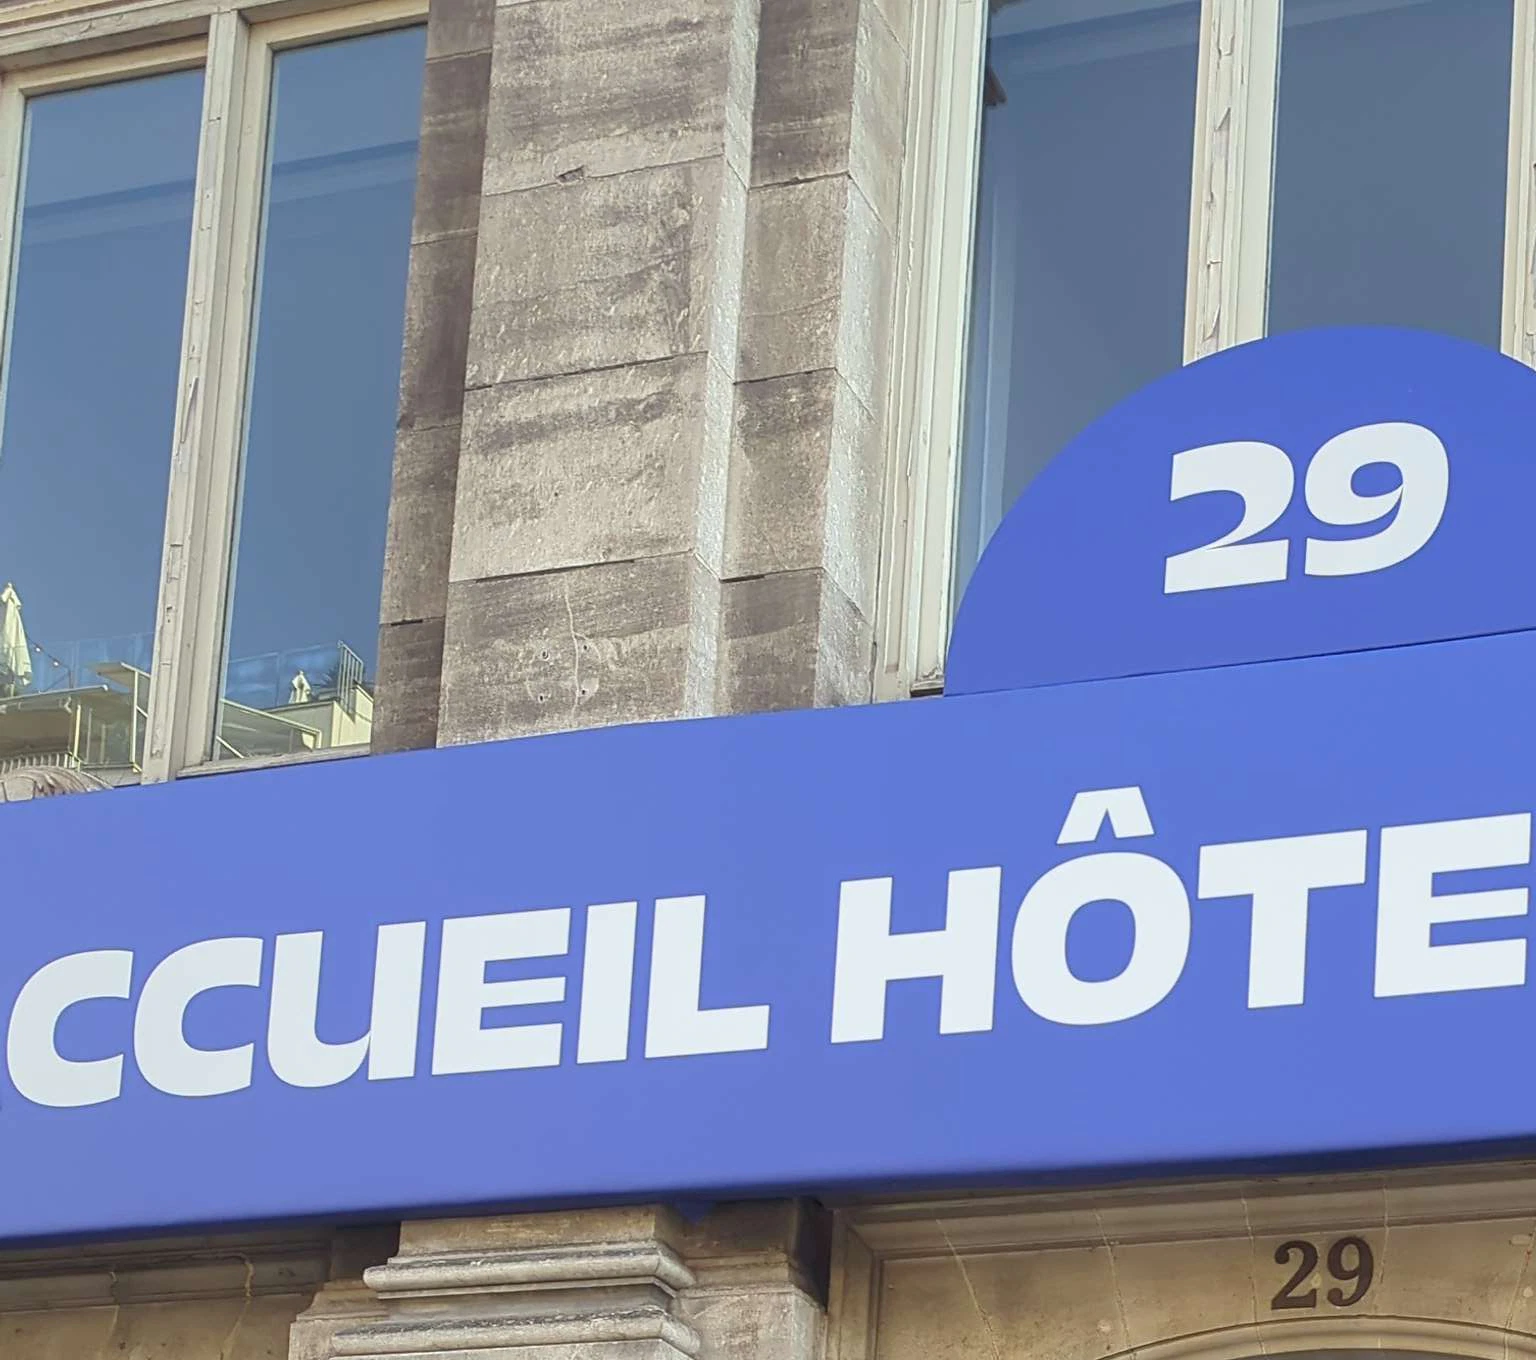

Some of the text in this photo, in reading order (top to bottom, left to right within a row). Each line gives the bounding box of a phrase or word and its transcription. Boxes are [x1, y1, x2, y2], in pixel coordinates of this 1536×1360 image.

[1163, 421, 1449, 595] 29
[6, 894, 770, 1109] CCUEIL
[1270, 1235, 1374, 1311] 29
